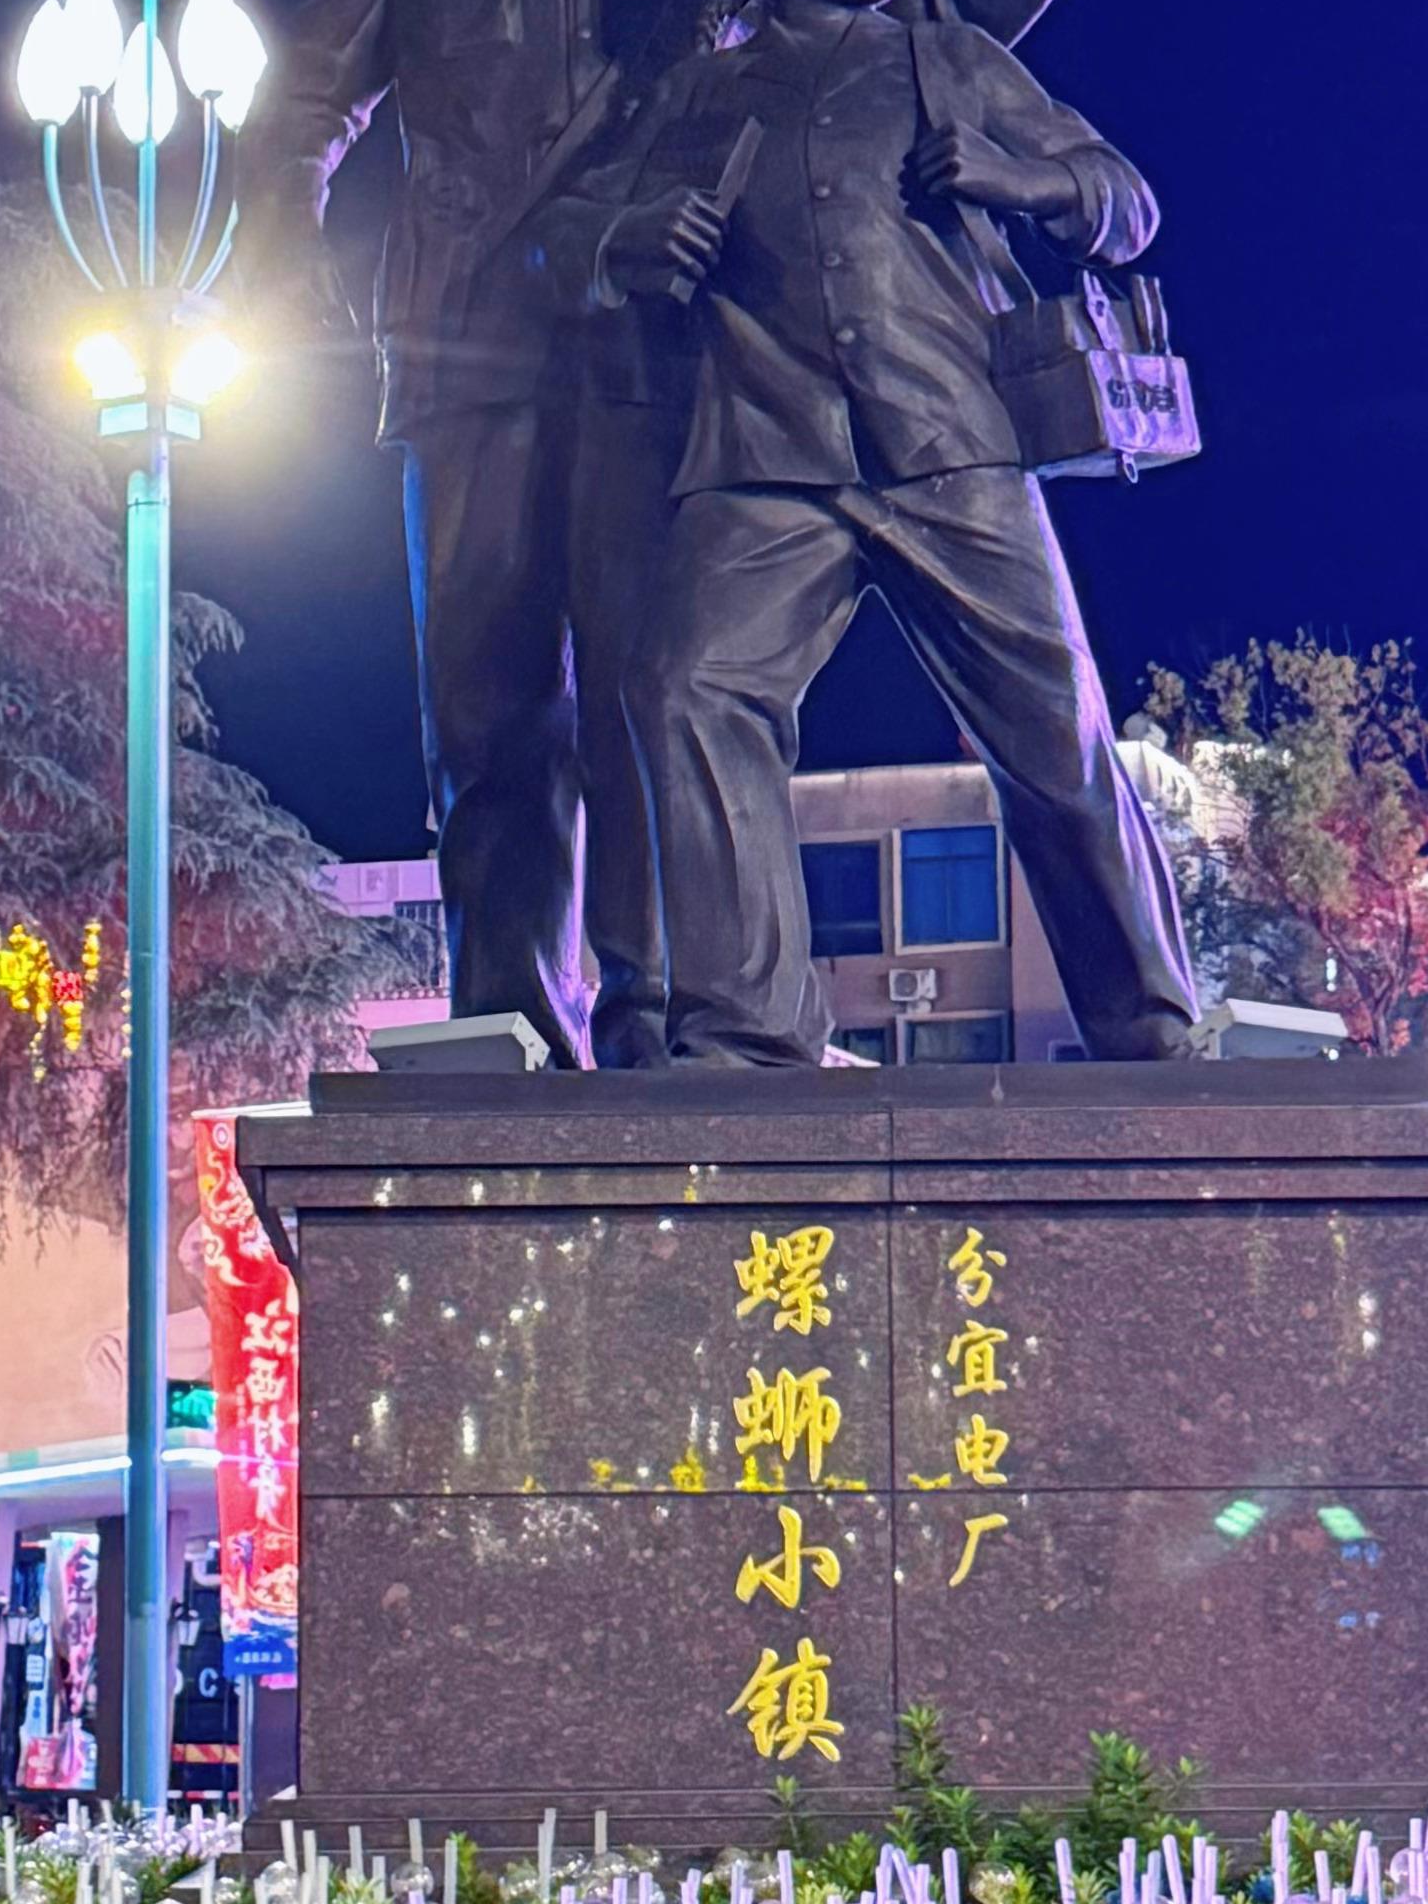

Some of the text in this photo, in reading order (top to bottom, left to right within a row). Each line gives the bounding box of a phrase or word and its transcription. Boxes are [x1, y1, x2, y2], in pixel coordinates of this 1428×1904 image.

[726, 1225, 845, 1762] 螺蛳小镇
[947, 1226, 1009, 1588] 分宜电厂
